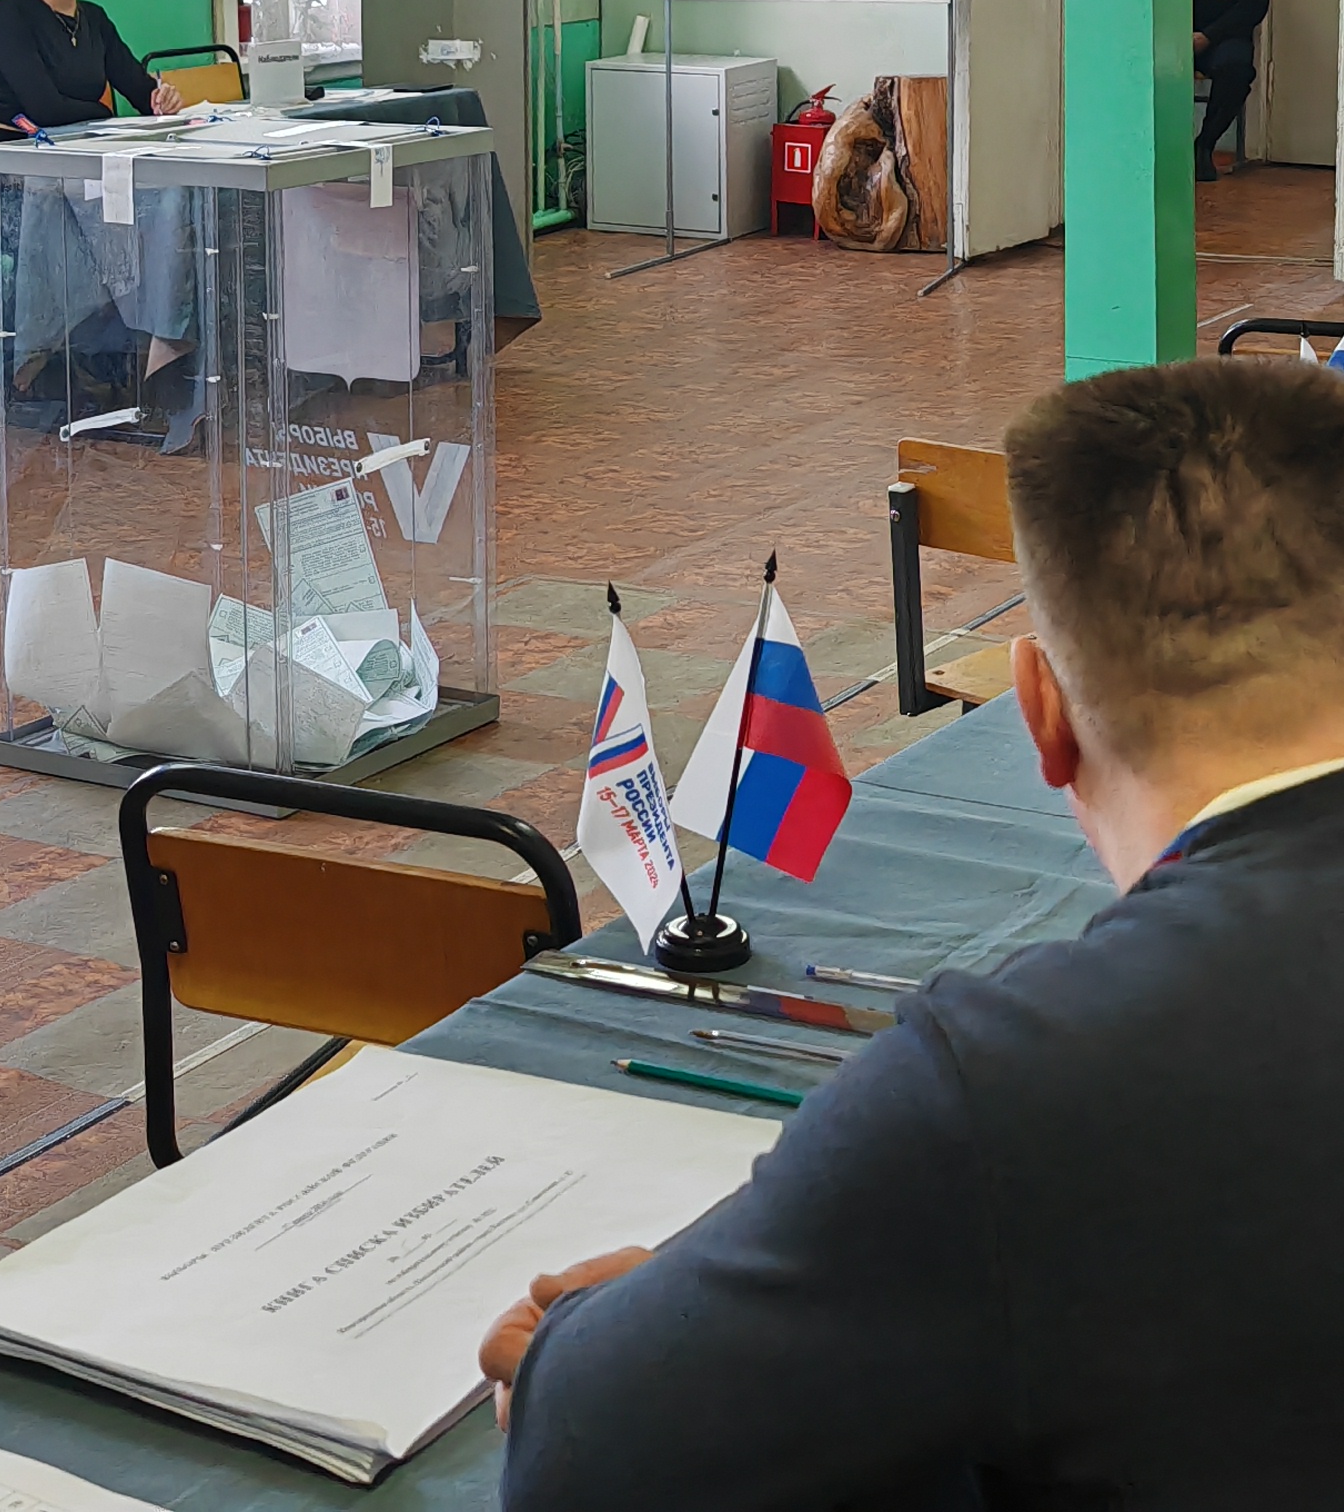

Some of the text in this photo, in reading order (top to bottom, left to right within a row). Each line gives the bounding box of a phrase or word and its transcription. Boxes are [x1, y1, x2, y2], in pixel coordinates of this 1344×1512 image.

[616, 778, 656, 843] РОССИИ
[636, 769, 675, 871] ПРЕЗИДЕНТА
[648, 761, 671, 832] ВЫБОРЫ
[621, 818, 650, 861] МАРТА
[644, 859, 659, 889] 2024
[324, 1229, 399, 1275] СПИСКА
